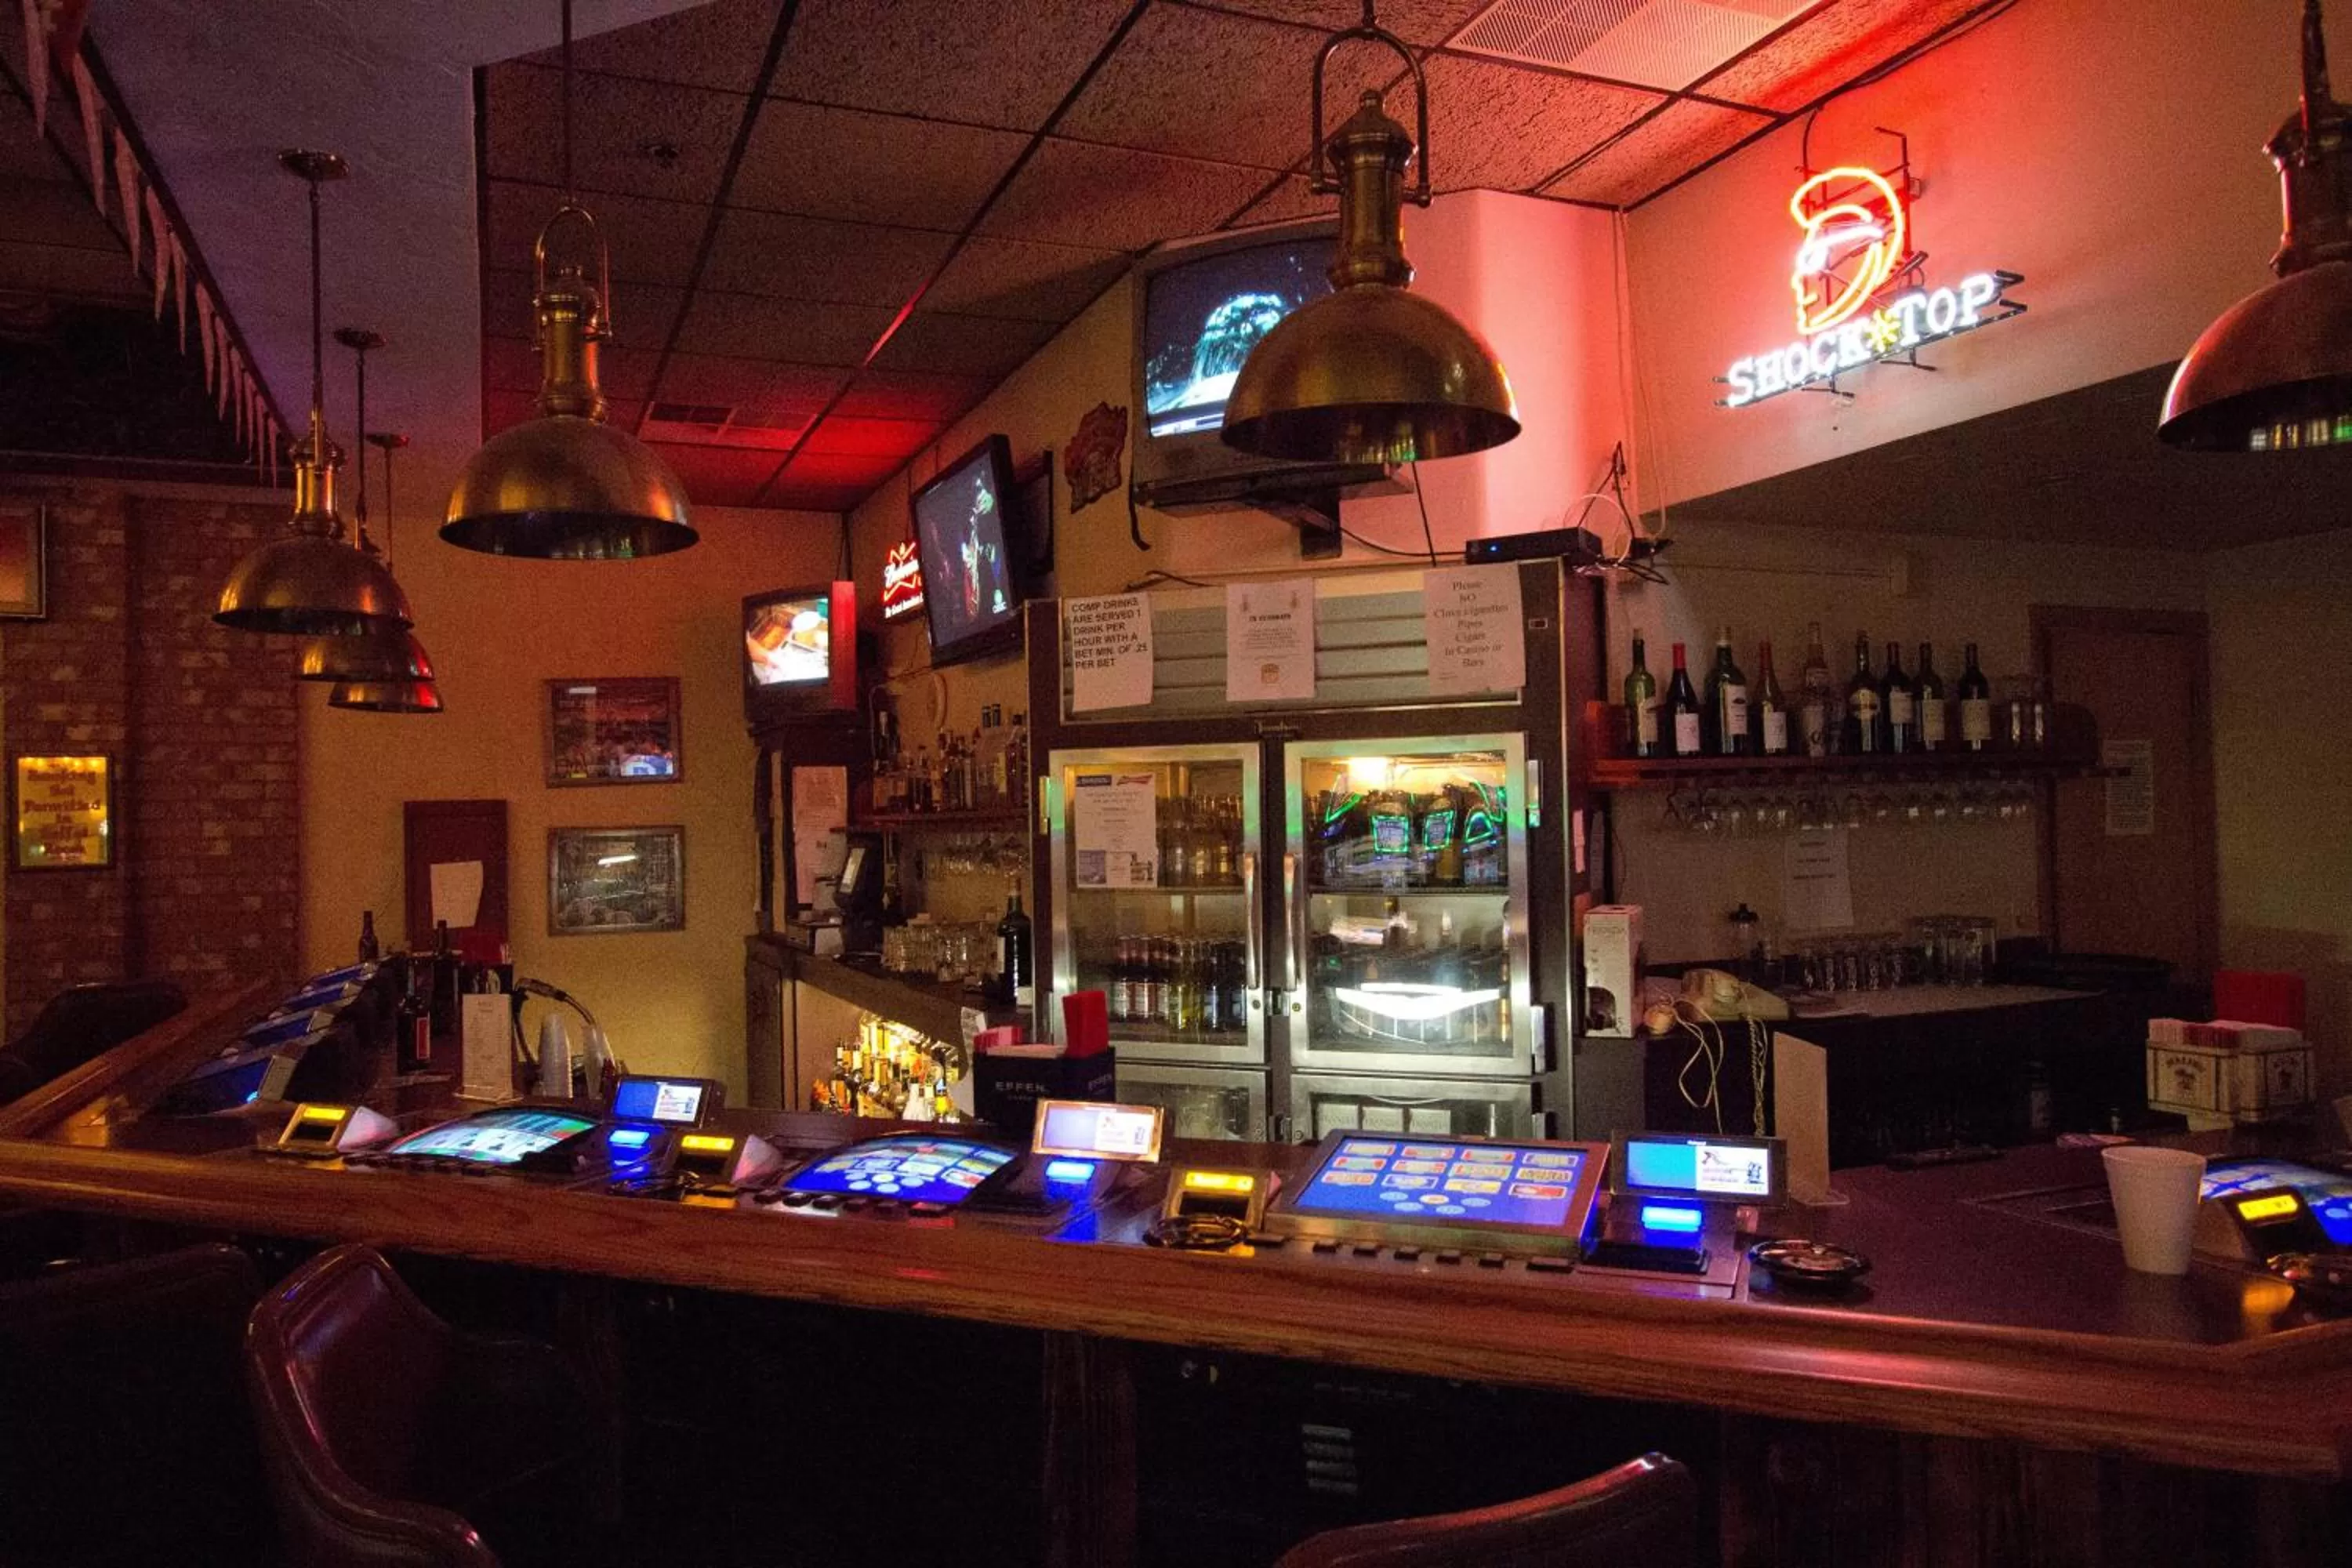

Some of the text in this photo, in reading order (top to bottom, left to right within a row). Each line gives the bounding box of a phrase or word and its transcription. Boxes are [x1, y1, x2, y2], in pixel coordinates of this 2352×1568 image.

[1727, 273, 1994, 408] SHOCK TOP
[1072, 597, 1138, 612] COMP DRINKS
[1095, 609, 1134, 622] SERVED
[1074, 622, 1126, 635] DRINK PER
[1074, 632, 1138, 647] HOUR WITH A
[1075, 648, 1093, 659] BET
[1076, 659, 1116, 669] PER BET
